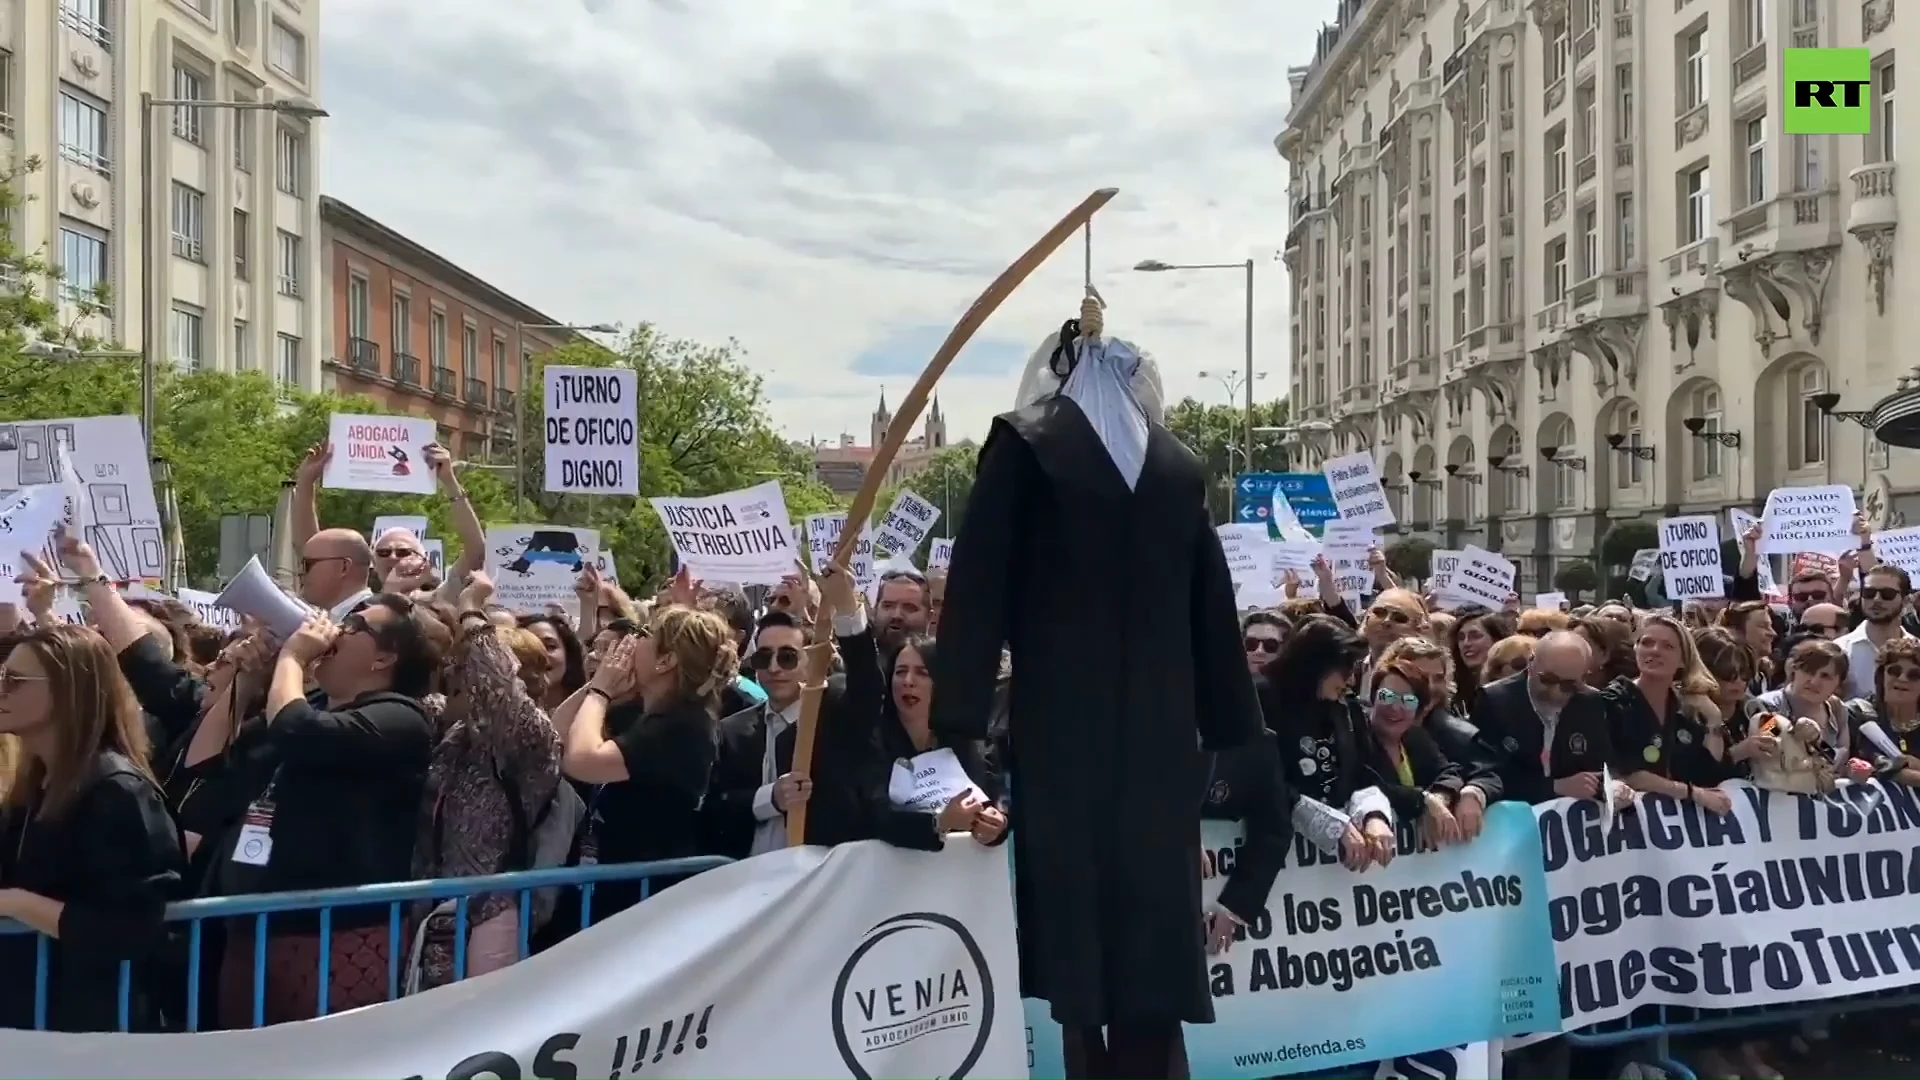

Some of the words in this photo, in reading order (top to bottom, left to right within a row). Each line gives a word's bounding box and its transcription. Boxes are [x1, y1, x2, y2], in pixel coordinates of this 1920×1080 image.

[556, 375, 621, 409] ¡TURNO
[348, 424, 409, 442] ABOGACÍA
[546, 417, 570, 444] DE
[575, 417, 633, 445] OFICIO
[348, 443, 386, 459] UNIDA
[562, 460, 623, 488] DIGNO!
[1774, 496, 1793, 505] NO
[1796, 493, 1840, 501] SOMOS
[663, 504, 737, 530] JUSTICIA
[672, 525, 787, 556] RETRIBUTIVA
[1665, 521, 1708, 546] ¡TURNO
[1662, 550, 1679, 570] DE
[1680, 548, 1718, 570] OFICIO
[1675, 575, 1715, 596] DIGNO!
[188, 600, 231, 626] STICIA
[1741, 787, 1771, 842] Y
[1283, 893, 1342, 936] los
[1353, 870, 1523, 927] Derechos
[1249, 929, 1442, 992] Abogacía
[855, 968, 969, 1022] VENIA
[1234, 1036, 1367, 1068] www.defenda.es
